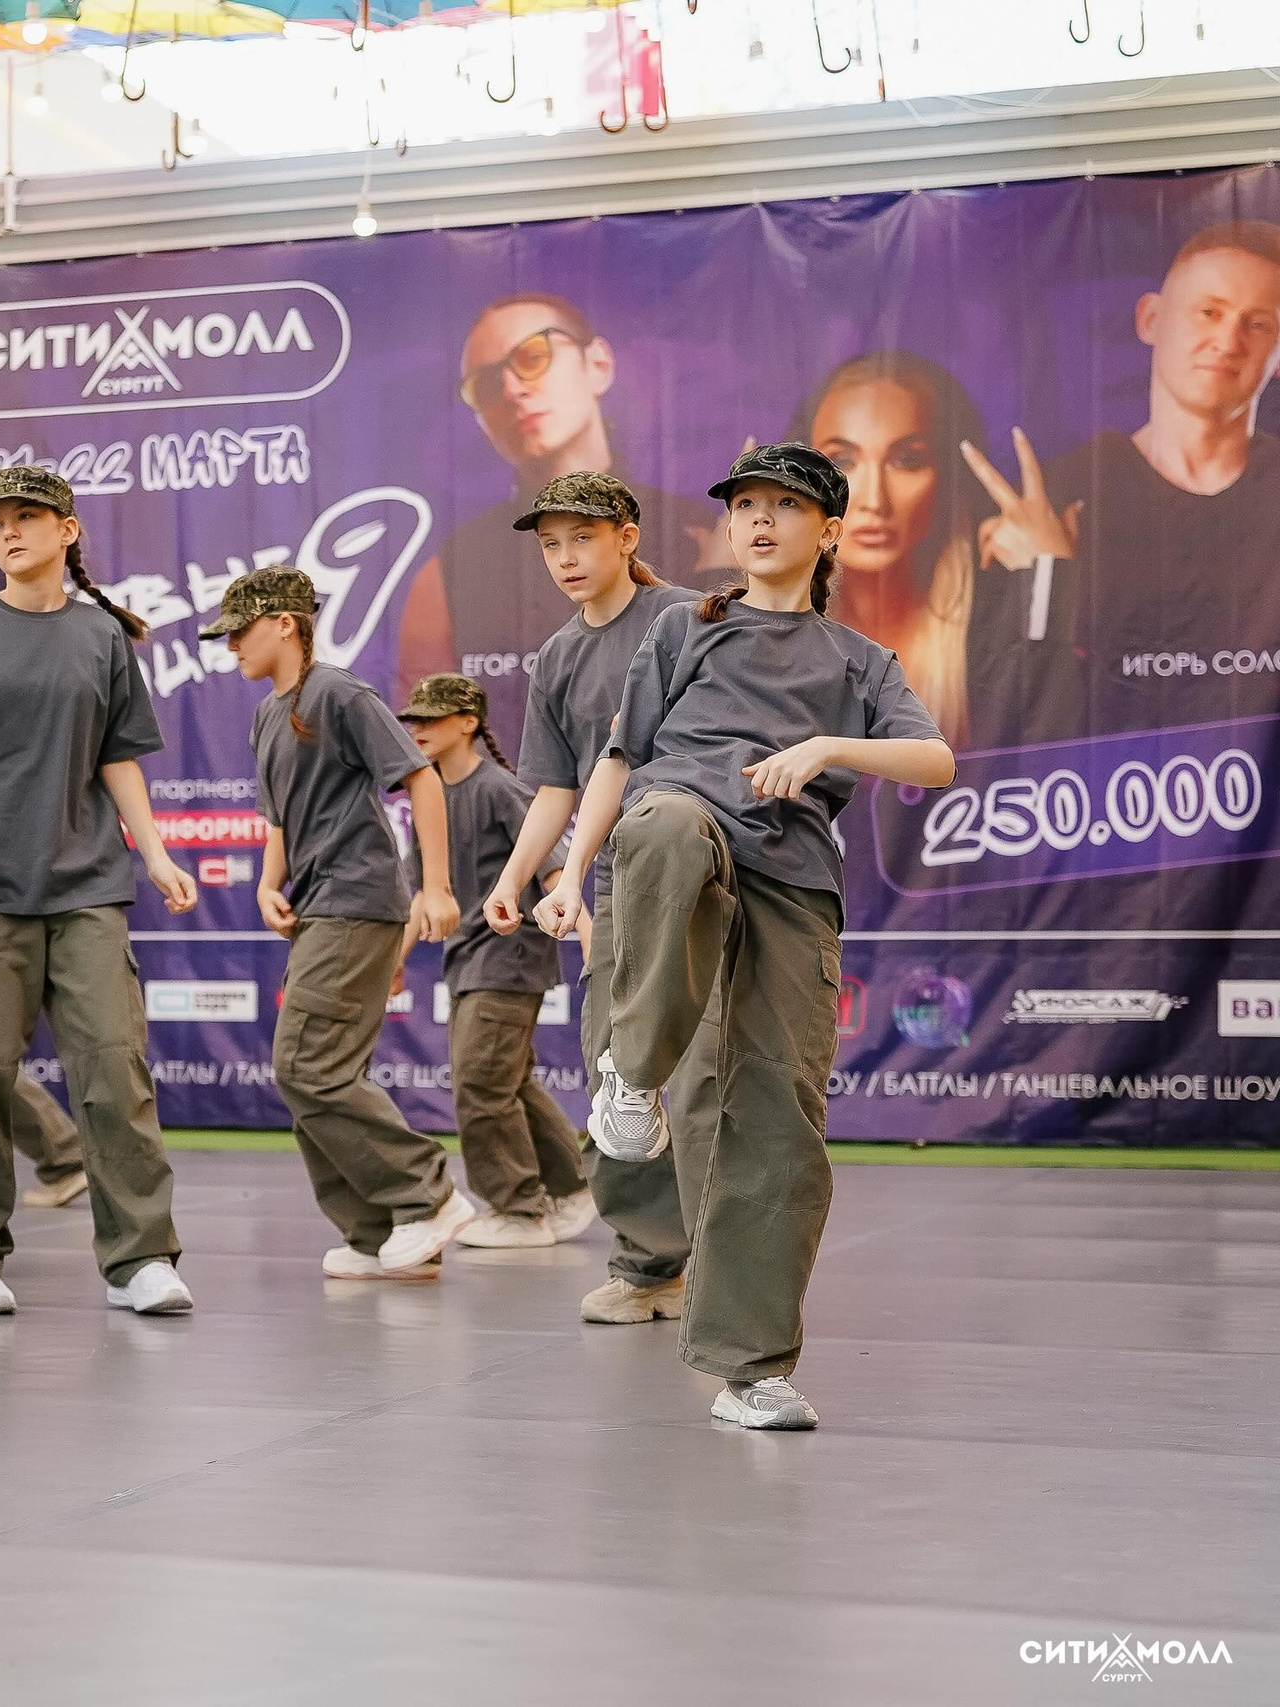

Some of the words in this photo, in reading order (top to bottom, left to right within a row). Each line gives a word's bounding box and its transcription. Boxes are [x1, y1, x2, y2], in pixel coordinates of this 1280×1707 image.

[141, 424, 312, 492] МАРТА
[461, 652, 520, 677] ЕГОР
[1122, 651, 1208, 677] ИГОРЬ
[921, 748, 1262, 867] 250.000
[149, 1059, 220, 1085] АТТЛЫ
[826, 1069, 862, 1096] ОУ
[883, 1070, 979, 1097] БАТТЛЫ
[1000, 1072, 1208, 1100] ТАНЦЕВАЛЬНОЕ
[1214, 1074, 1280, 1101] ШОУ
